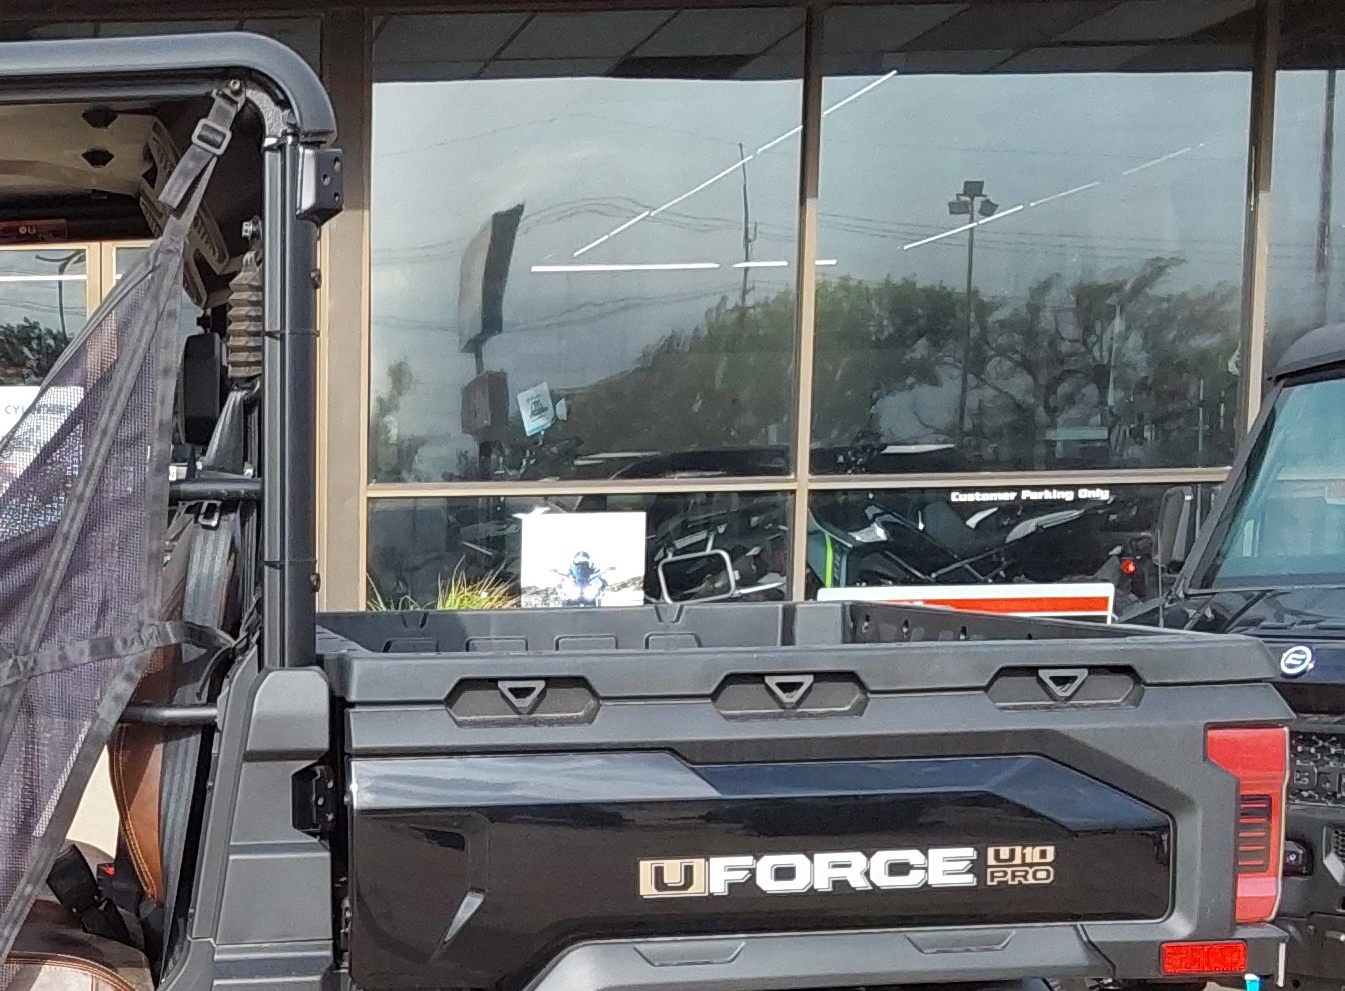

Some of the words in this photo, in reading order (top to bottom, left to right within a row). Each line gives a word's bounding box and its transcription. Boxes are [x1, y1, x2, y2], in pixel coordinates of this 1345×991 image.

[950, 492, 1017, 502] Customer
[1021, 489, 1074, 501] Parking
[1078, 488, 1110, 500] Only
[986, 845, 1055, 866] U10
[986, 866, 1054, 886] PRO
